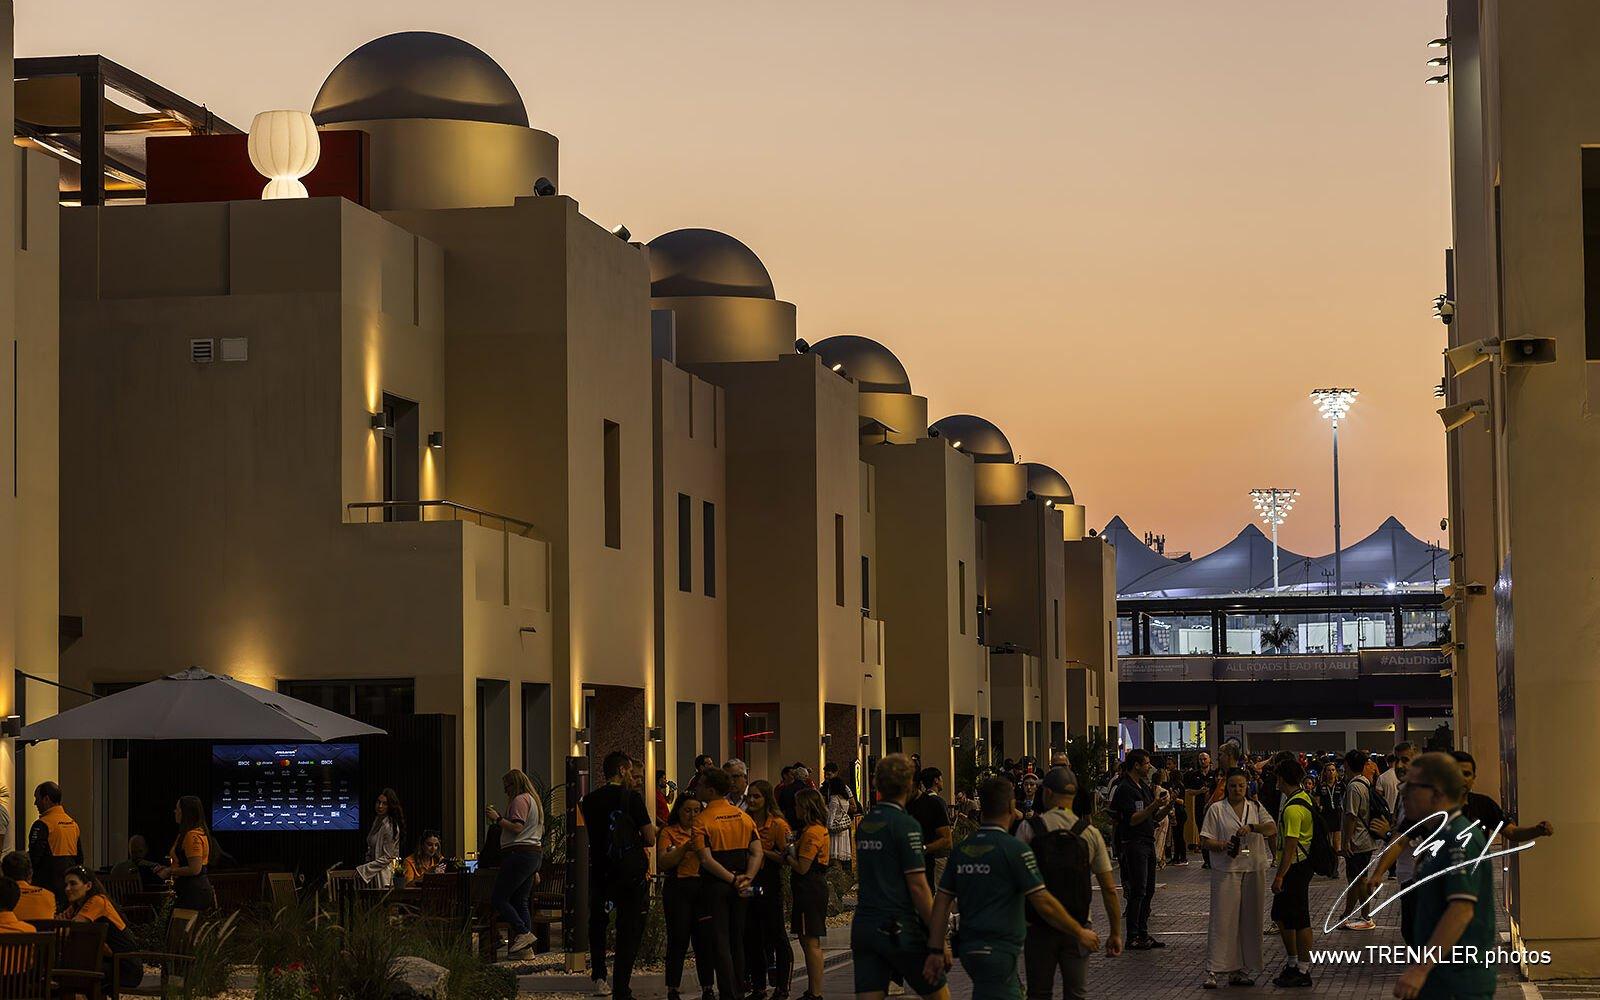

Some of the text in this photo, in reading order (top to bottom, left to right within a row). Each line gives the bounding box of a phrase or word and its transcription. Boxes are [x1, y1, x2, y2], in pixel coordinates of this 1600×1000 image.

[1226, 663, 1246, 672] ALL
[1247, 662, 1283, 672] ROADS
[1284, 662, 1311, 671] LEAD
[1314, 662, 1326, 671] TO
[1329, 661, 1352, 670] ABU
